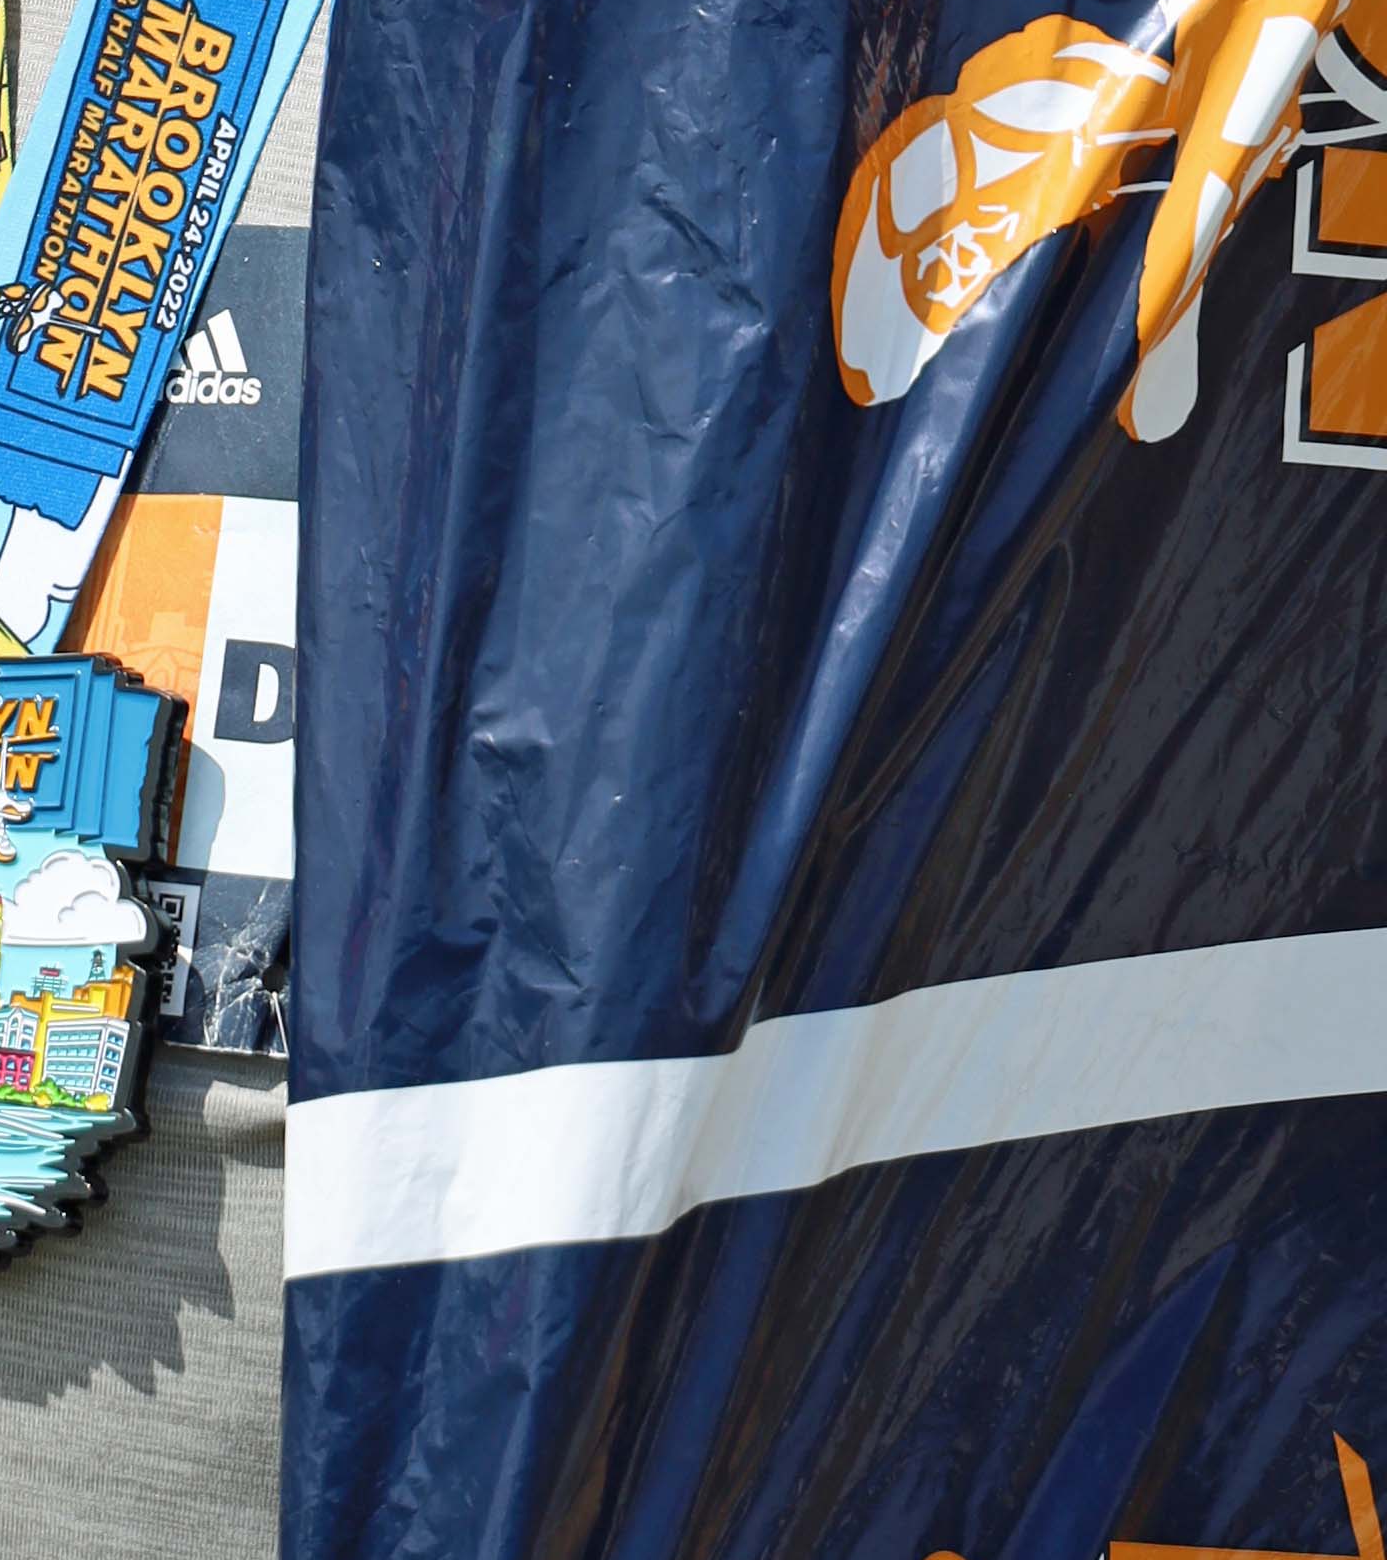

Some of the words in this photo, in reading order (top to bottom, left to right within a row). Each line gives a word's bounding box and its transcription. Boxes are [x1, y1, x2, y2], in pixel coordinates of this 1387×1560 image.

[91, 10, 135, 101] HALF
[33, 102, 106, 283] MARATHON
[198, 115, 239, 205] APRIL
[159, 370, 262, 406] didas
[213, 638, 296, 744] D
